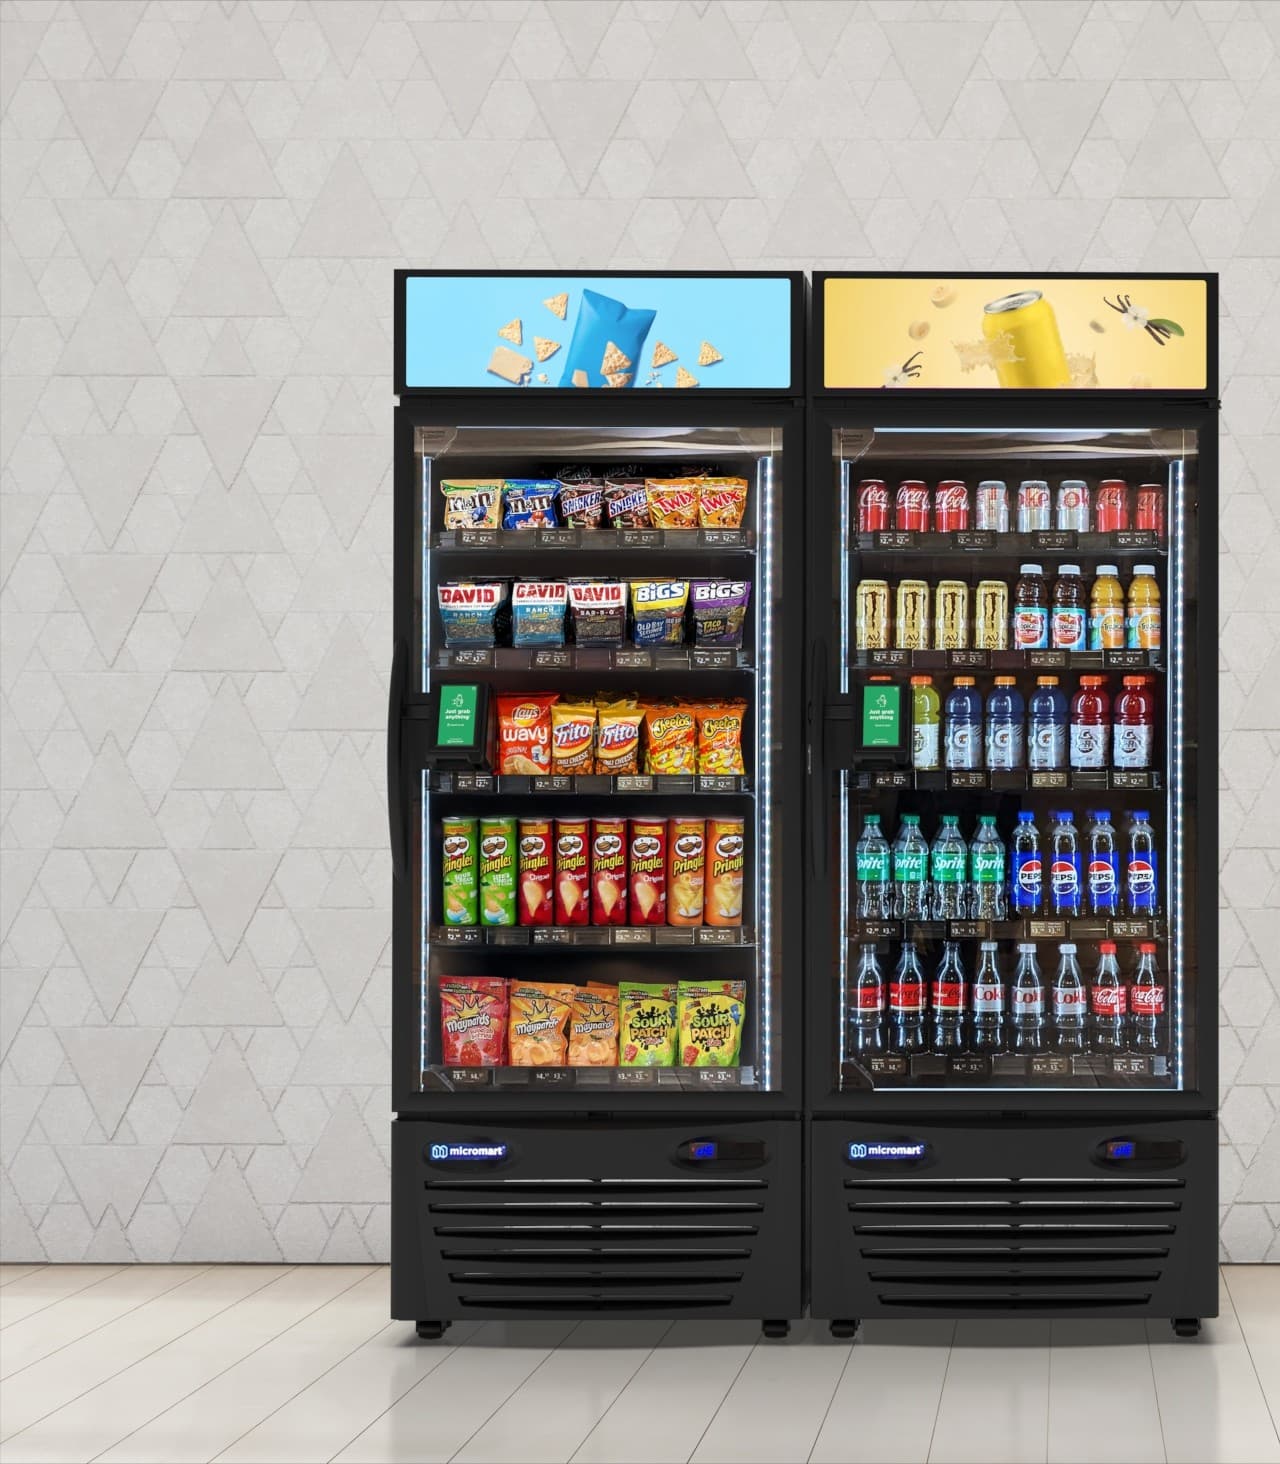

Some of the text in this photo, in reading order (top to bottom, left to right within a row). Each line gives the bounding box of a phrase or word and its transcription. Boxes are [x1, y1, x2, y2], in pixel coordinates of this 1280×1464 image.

[562, 490, 604, 516] SNICKER
[610, 489, 647, 516] SNICKER
[440, 589, 495, 603] DAVID
[516, 584, 565, 598] DAVID
[573, 586, 621, 602] DAVID
[704, 620, 721, 630] TACO
[652, 713, 691, 739] Cheetos
[502, 726, 548, 744] wavy
[553, 721, 591, 747] Frito
[594, 854, 624, 873] Pringles
[631, 857, 663, 874] Pringles
[673, 855, 704, 877] Pringle
[713, 855, 743, 877] Pringl
[857, 857, 884, 870] prite
[895, 857, 922, 870] prite
[975, 857, 1004, 871] Sprit
[446, 1013, 490, 1033] Maynards
[632, 1015, 667, 1028] SOUR
[693, 1013, 729, 1028] SOUR
[630, 1027, 667, 1041] PATCH
[691, 1027, 731, 1041] PATCH
[450, 1145, 502, 1156] micromart
[868, 1144, 921, 1155] micromart
